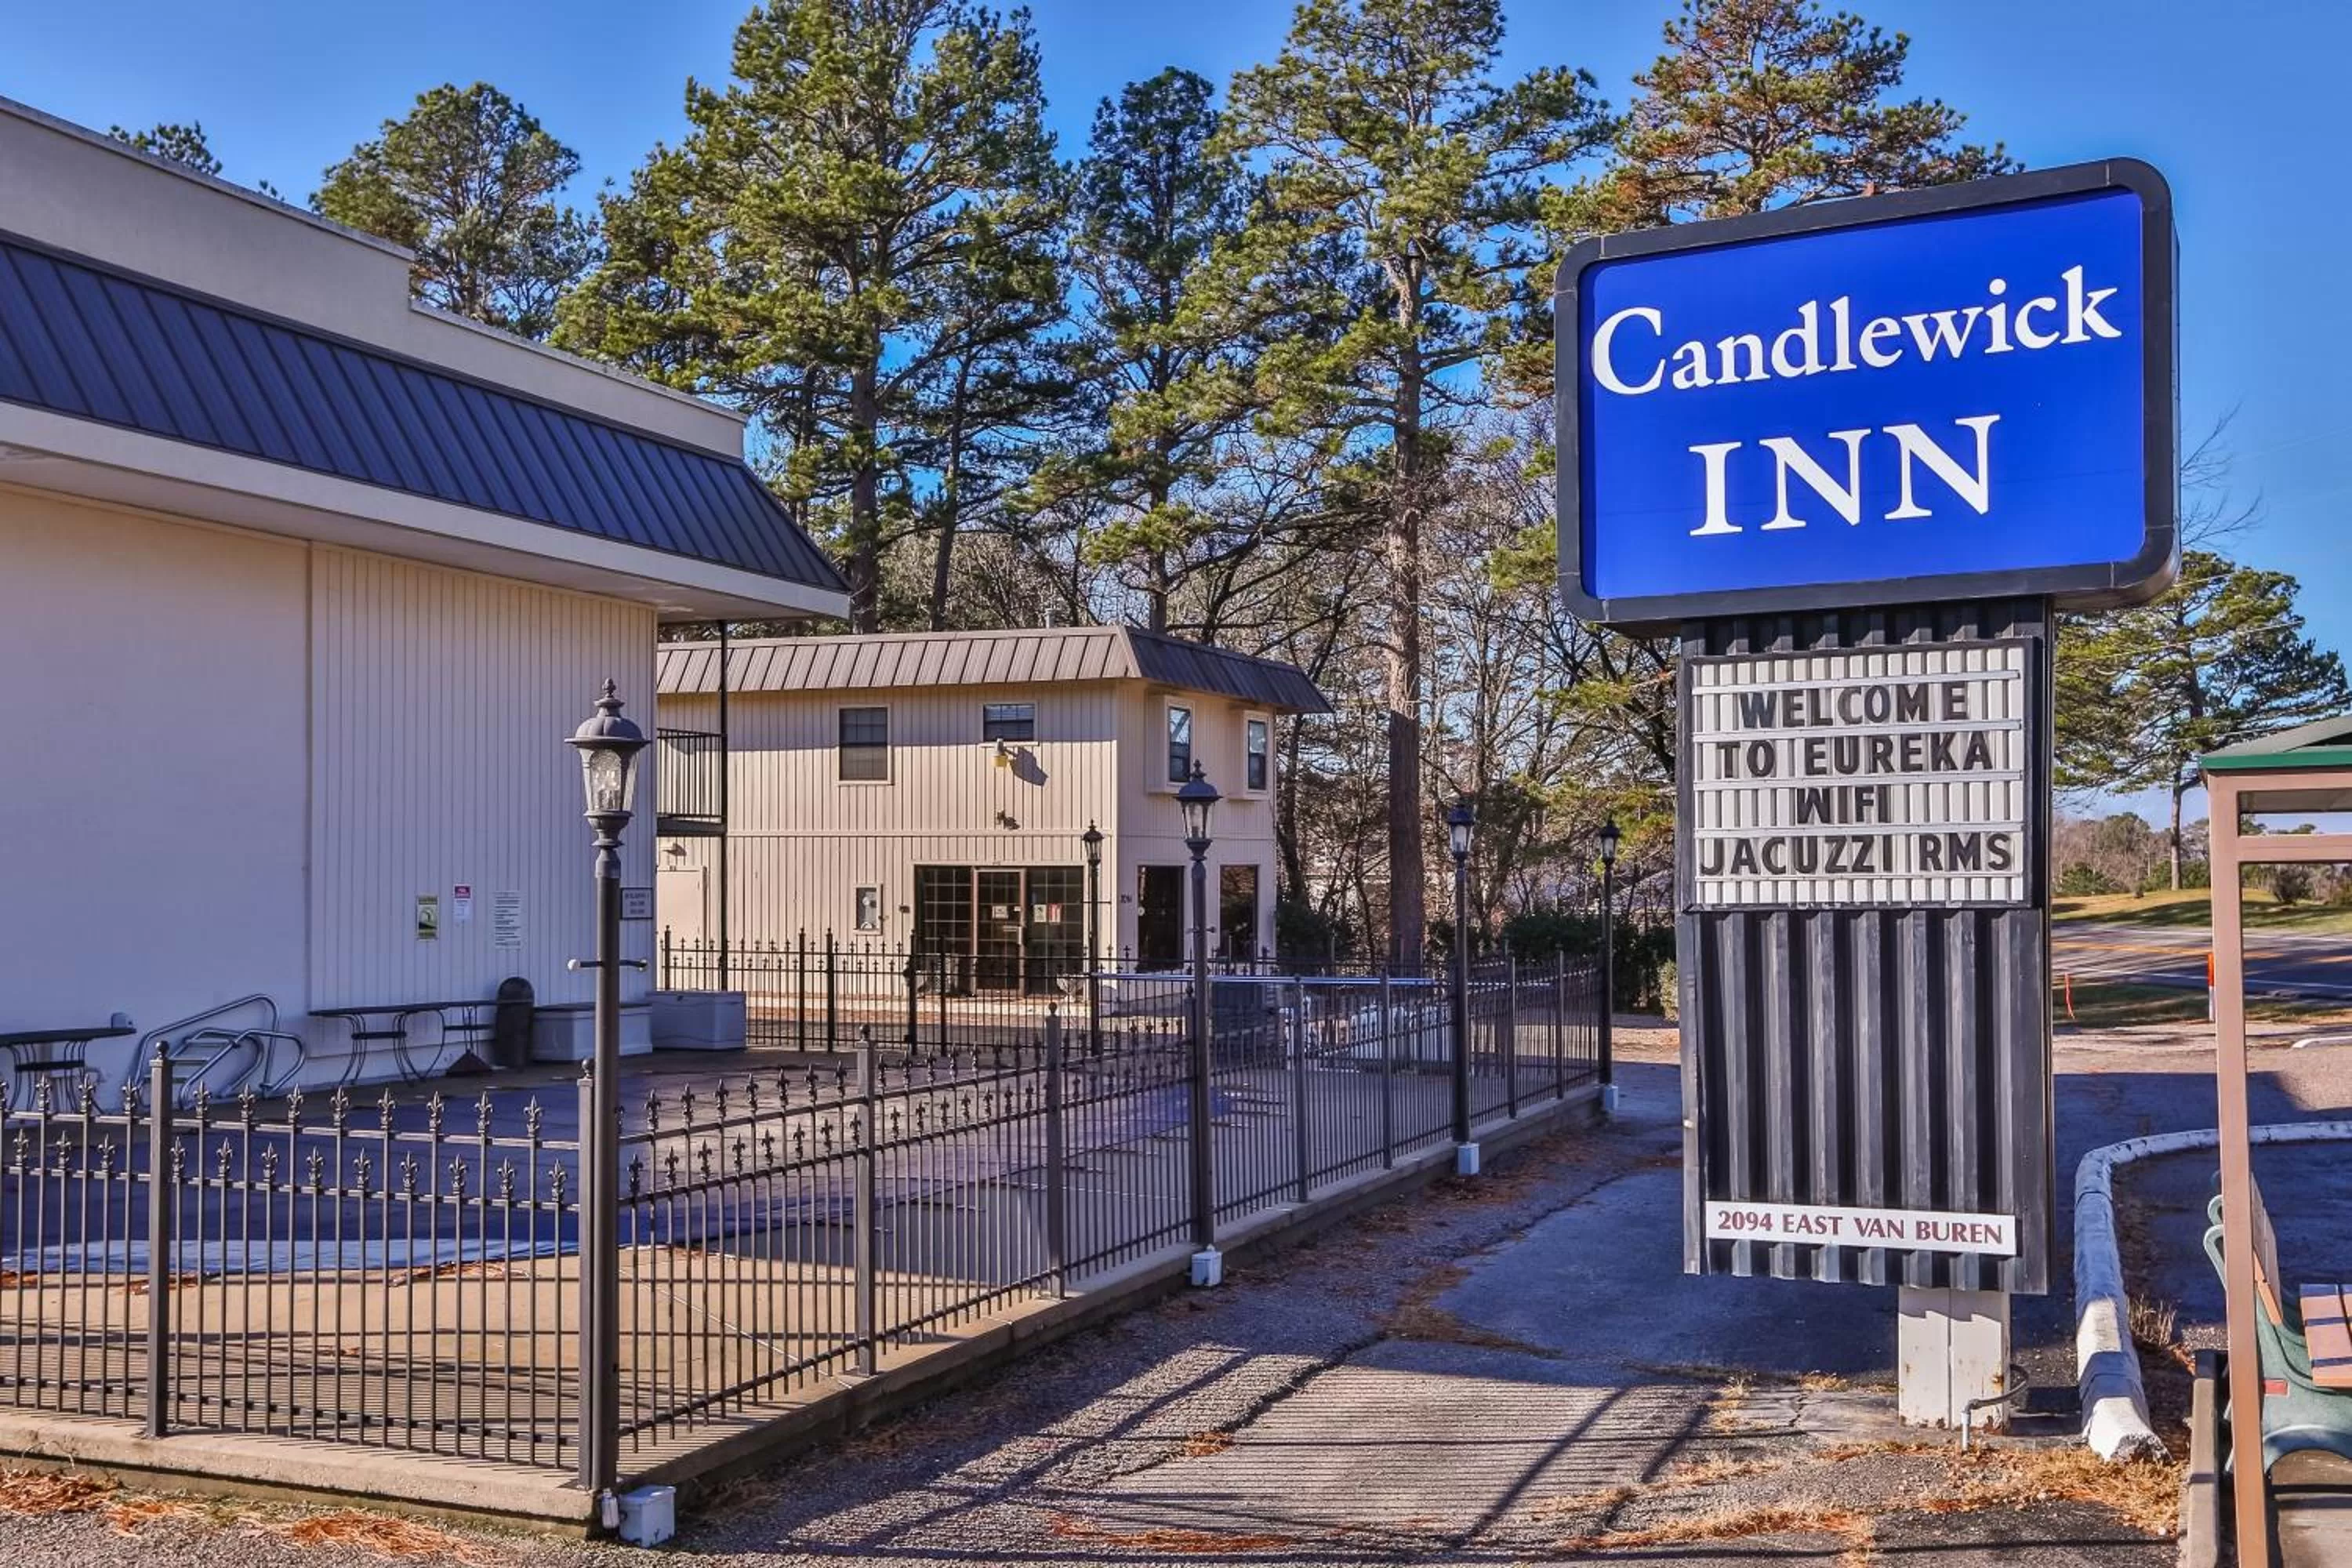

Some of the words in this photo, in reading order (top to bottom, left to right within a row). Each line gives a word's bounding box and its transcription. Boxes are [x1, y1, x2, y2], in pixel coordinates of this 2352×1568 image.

[1592, 264, 2122, 395] Candlewick
[1688, 415, 2000, 536] INN
[1740, 681, 1968, 728] WELCOME
[1716, 740, 1776, 777] TO
[1805, 731, 1993, 775] EUREKA
[1797, 786, 1889, 823] WIFI
[1700, 834, 1893, 875] JACUZZI
[1919, 833, 2012, 872] RMS
[1717, 1210, 1773, 1232] 2094
[1783, 1212, 1843, 1236] EAST
[1854, 1216, 1905, 1239] VAN
[1915, 1220, 2002, 1245] BUREN
